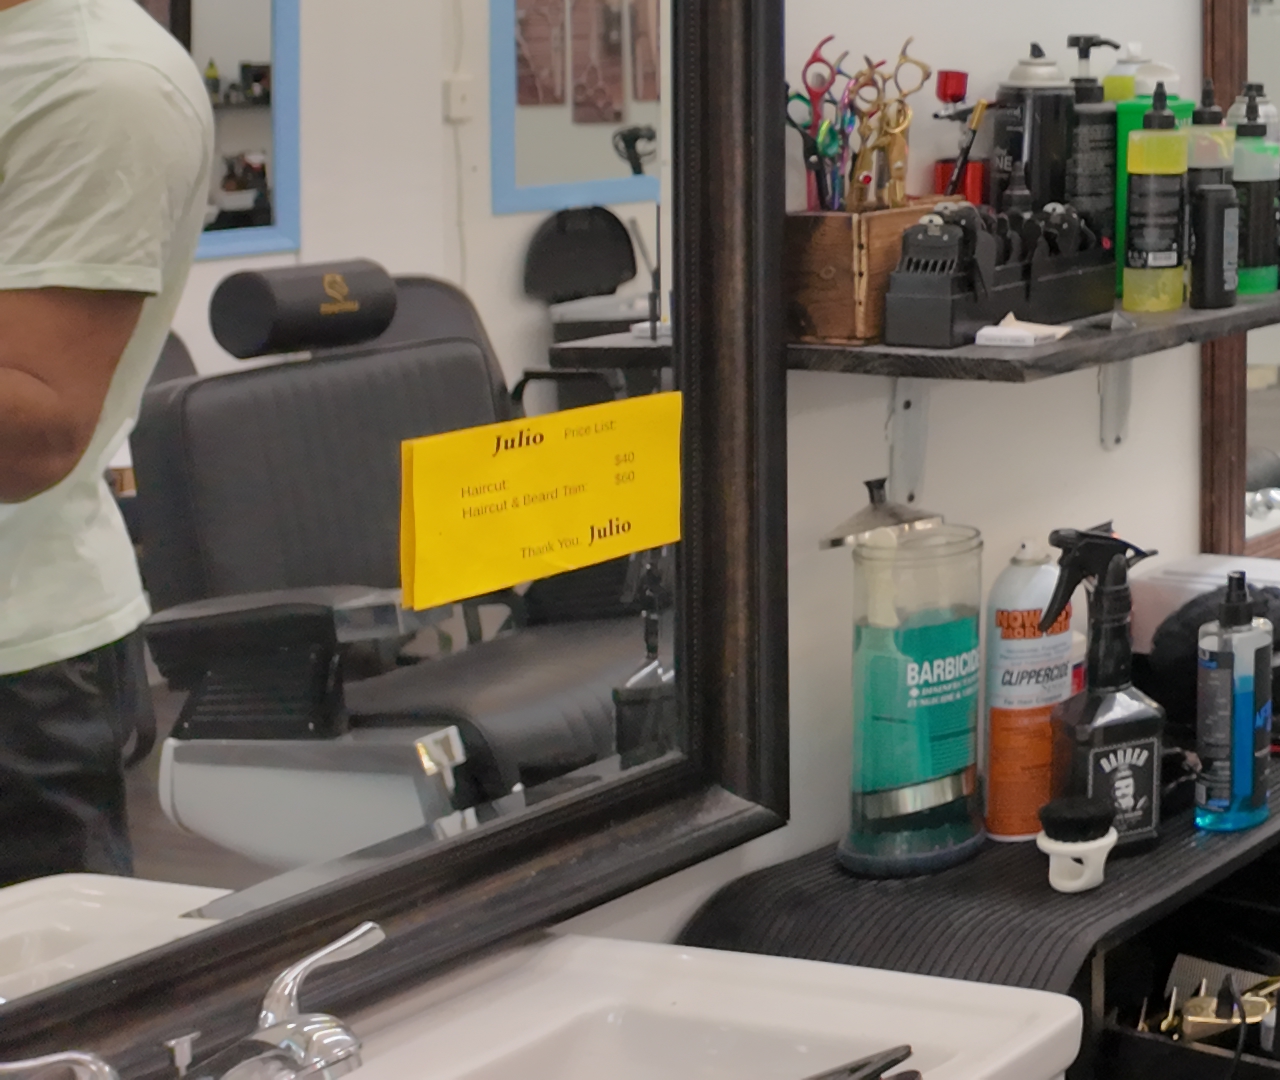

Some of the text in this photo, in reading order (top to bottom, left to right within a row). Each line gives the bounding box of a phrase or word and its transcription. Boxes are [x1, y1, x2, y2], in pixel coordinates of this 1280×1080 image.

[492, 428, 545, 458] Julio
[564, 425, 591, 439] Price
[615, 452, 635, 466] $40
[615, 471, 635, 486] $60
[462, 500, 507, 519] Haircut
[511, 496, 519, 509] &
[523, 488, 558, 506] Beard
[520, 541, 554, 559] Thank
[589, 517, 632, 547] Julio
[996, 608, 1042, 628] NOW
